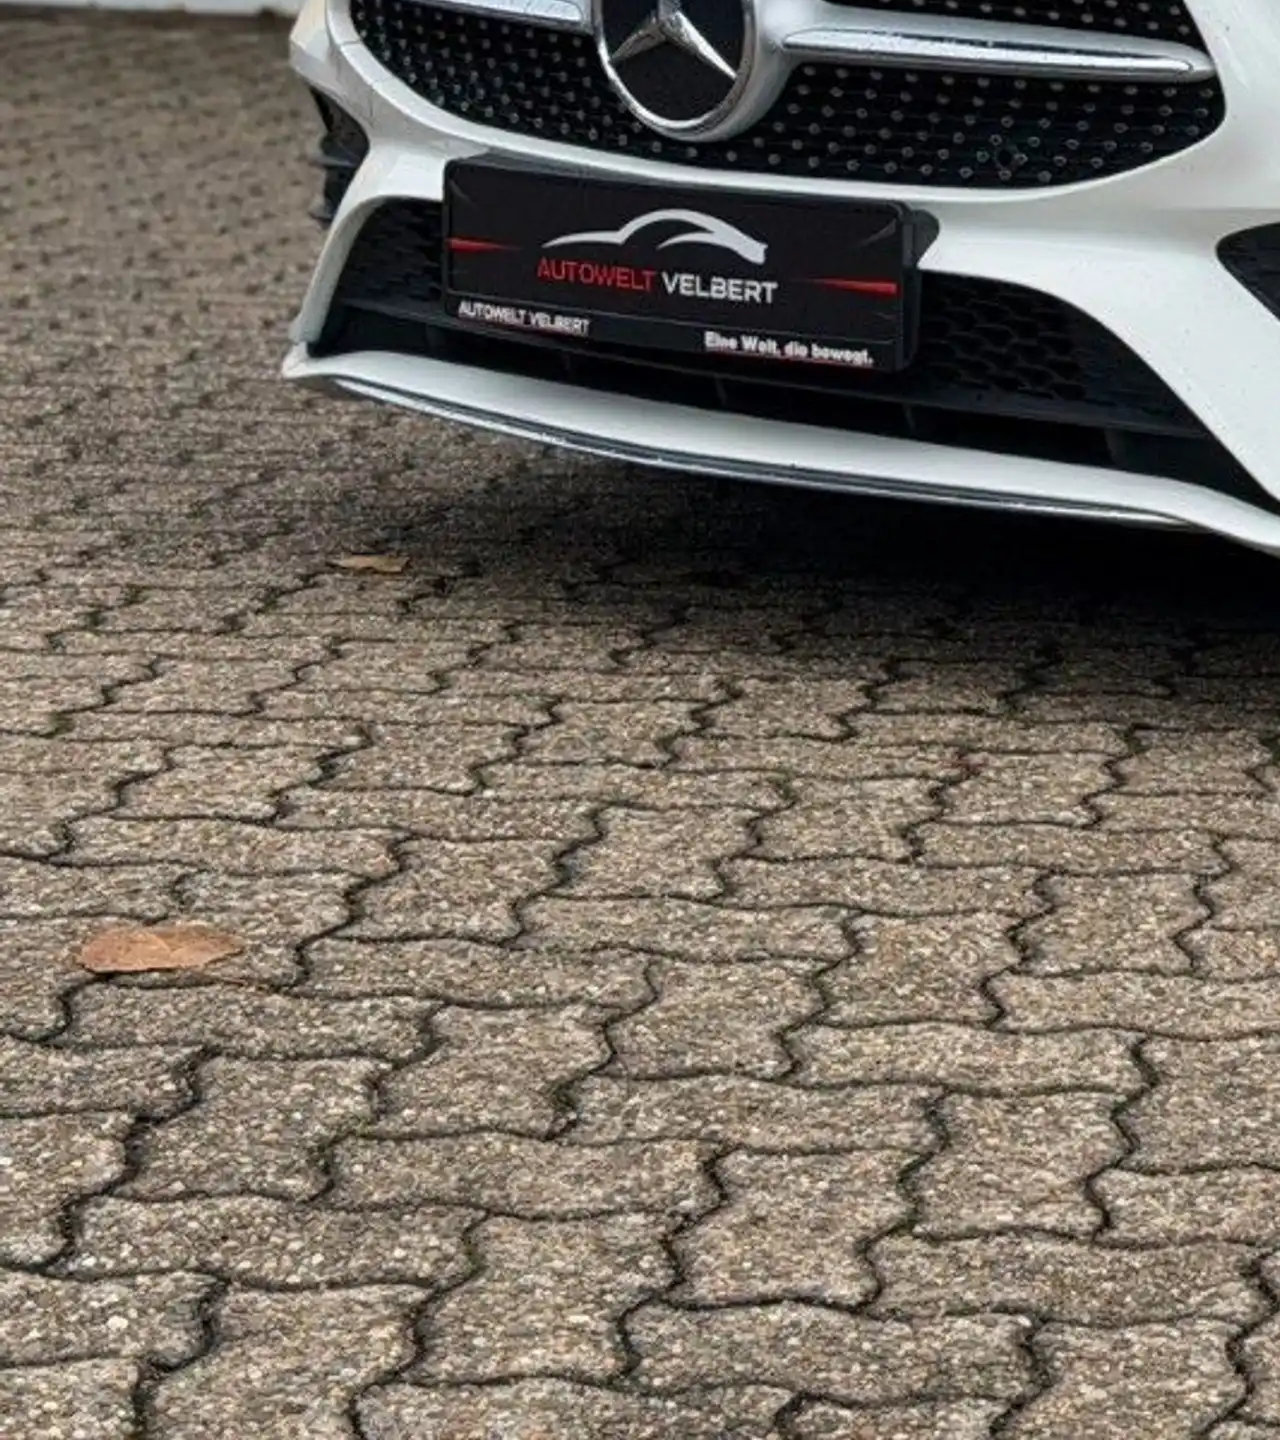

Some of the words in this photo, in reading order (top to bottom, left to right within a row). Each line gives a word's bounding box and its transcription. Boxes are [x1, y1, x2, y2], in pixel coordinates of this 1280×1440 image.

[537, 256, 657, 292] AUTOWELT
[661, 270, 778, 305] VELBERT
[458, 299, 527, 327] AUTOWELT
[529, 311, 590, 336] VELBERT
[704, 330, 738, 350] Eine
[784, 340, 808, 359] die
